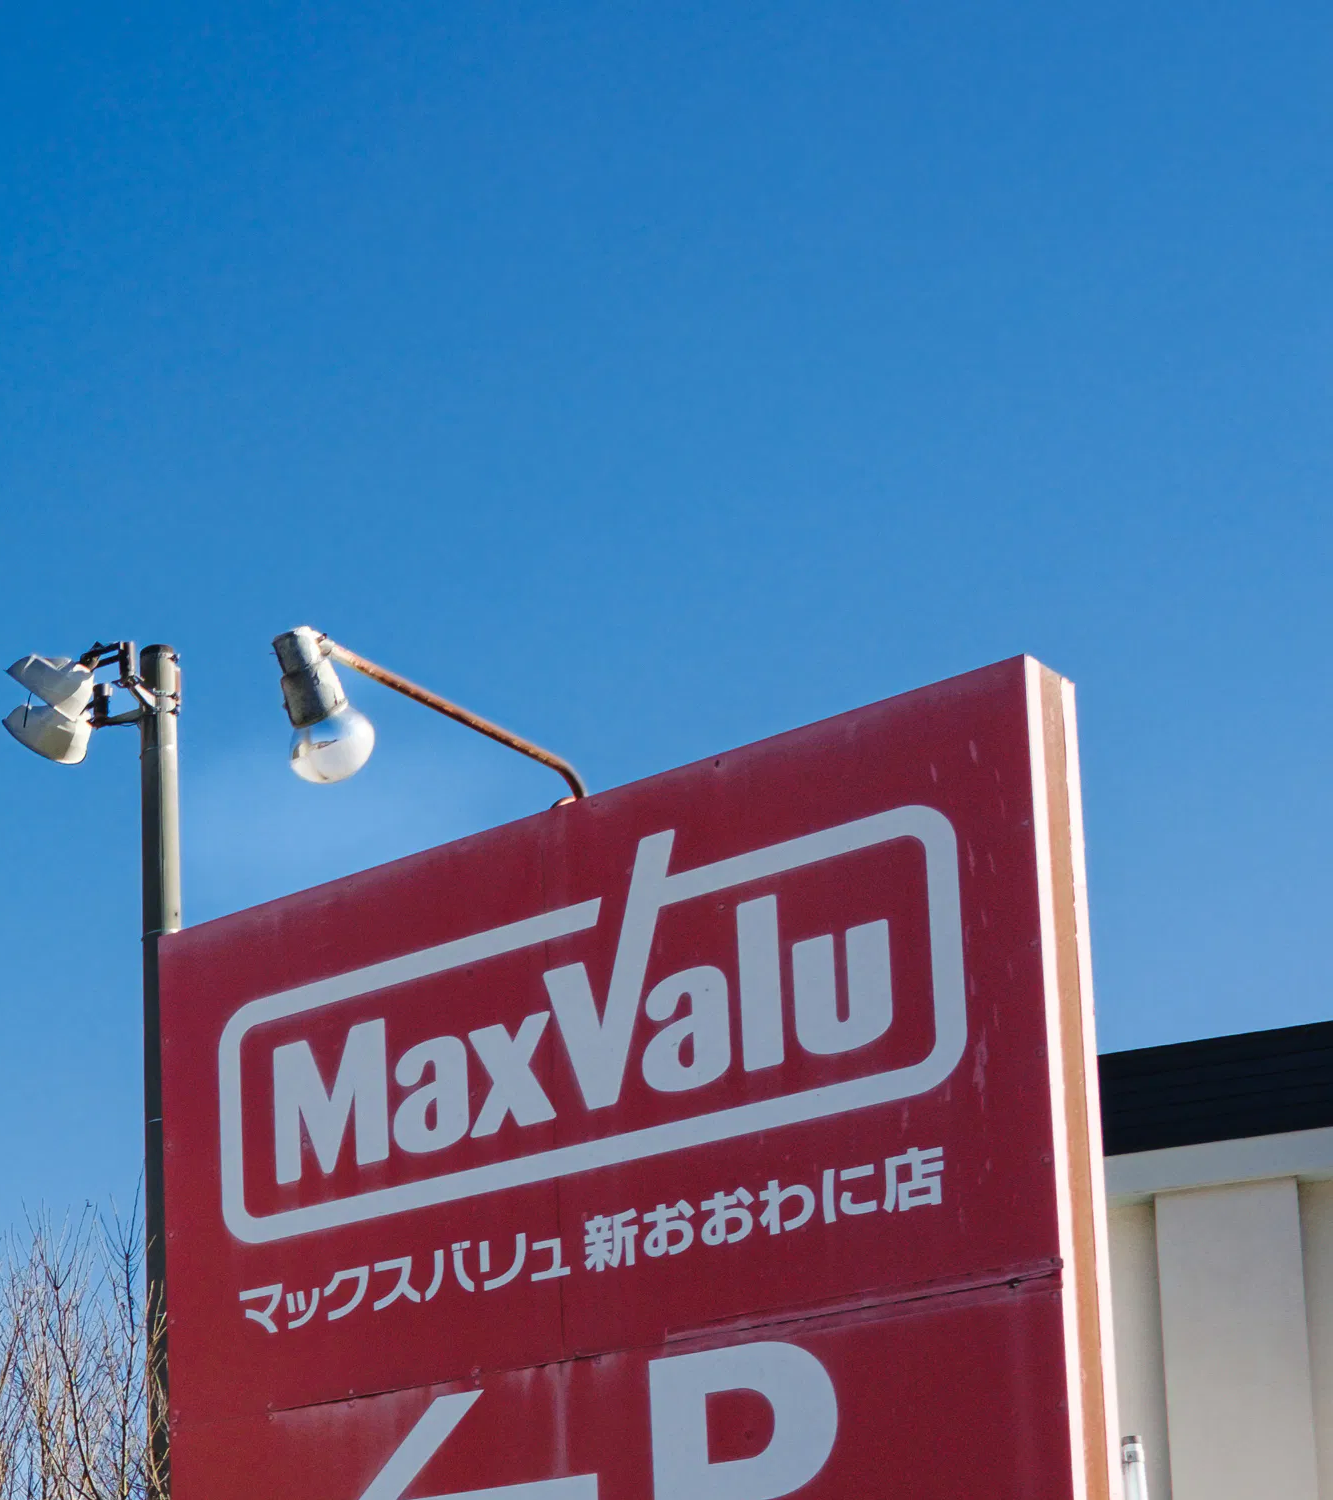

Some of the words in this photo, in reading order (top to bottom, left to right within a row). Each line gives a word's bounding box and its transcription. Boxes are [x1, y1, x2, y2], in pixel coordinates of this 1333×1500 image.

[272, 828, 895, 1187] MaxValu
[238, 1233, 572, 1335] マックスバリュ
[583, 1146, 946, 1274] 新おおわに店
